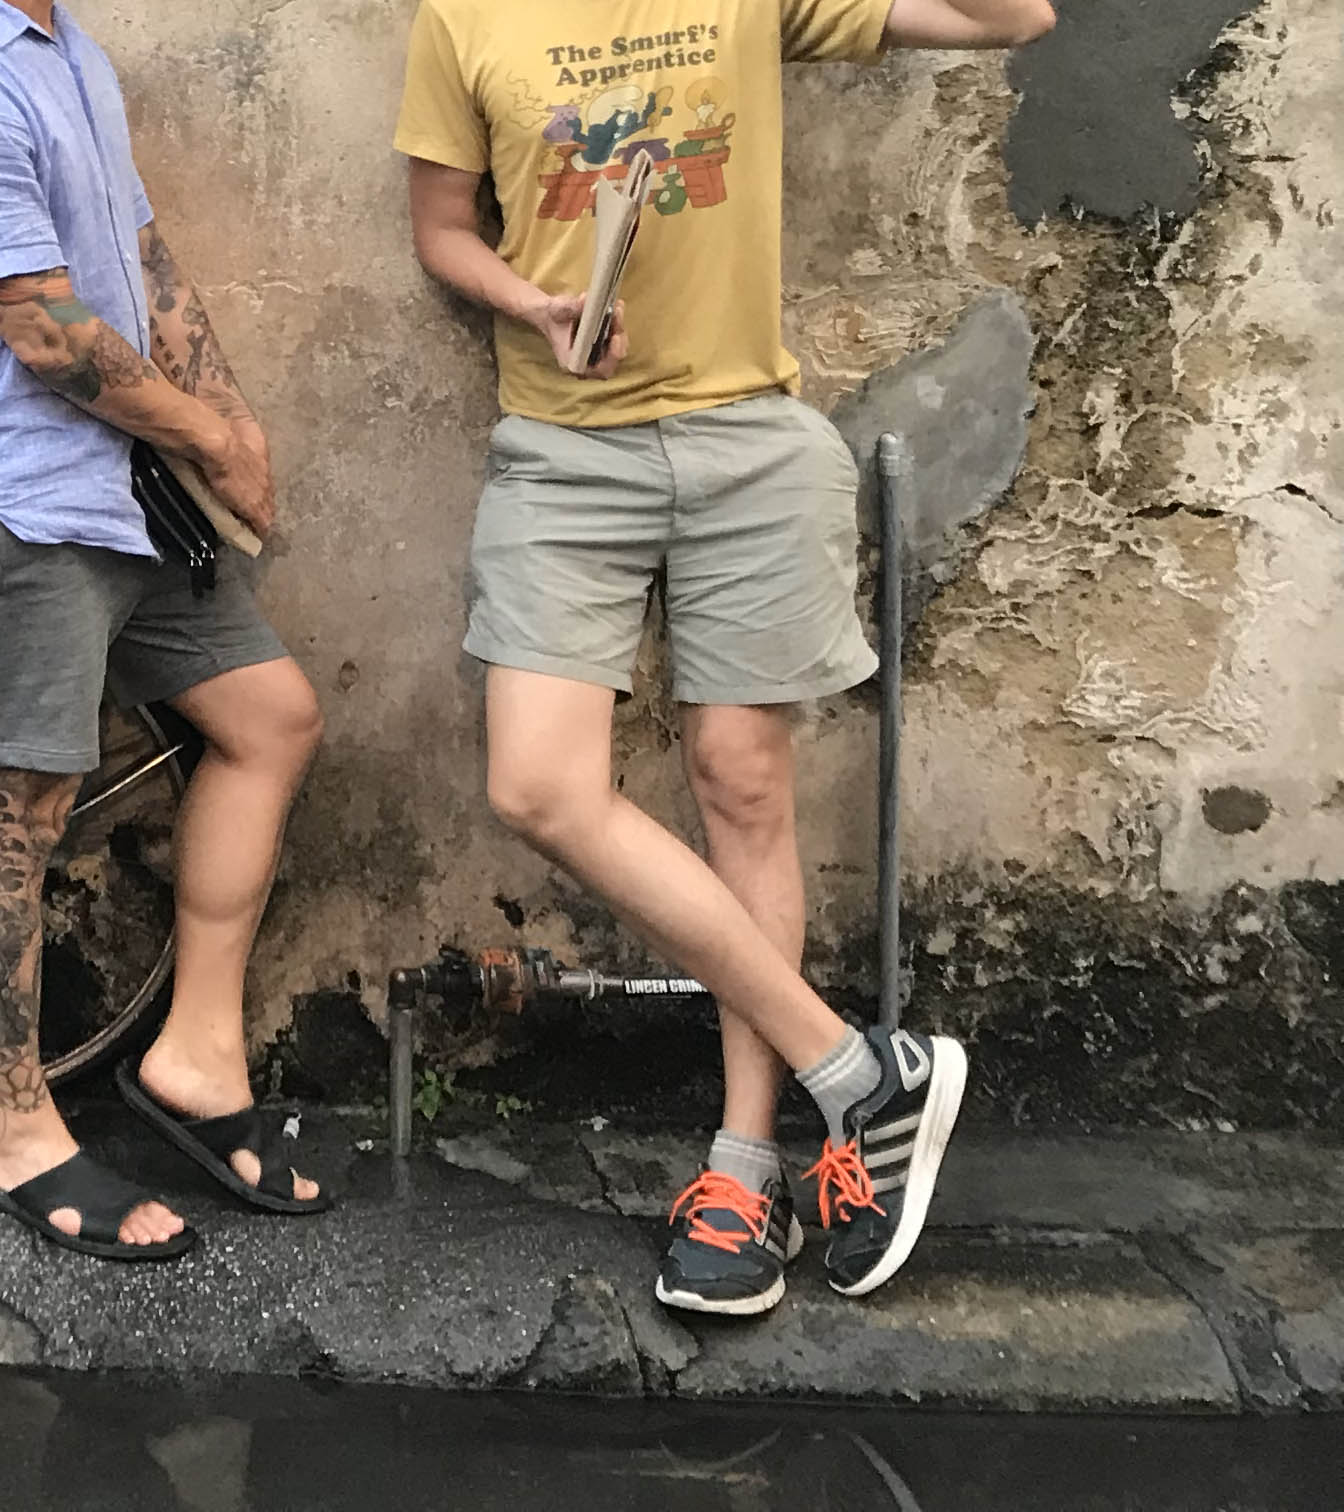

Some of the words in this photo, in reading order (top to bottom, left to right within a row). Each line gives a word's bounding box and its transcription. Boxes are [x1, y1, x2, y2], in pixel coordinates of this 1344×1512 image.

[546, 44, 602, 65] The
[610, 23, 719, 57] Smurf's
[555, 47, 716, 87] Apprentice
